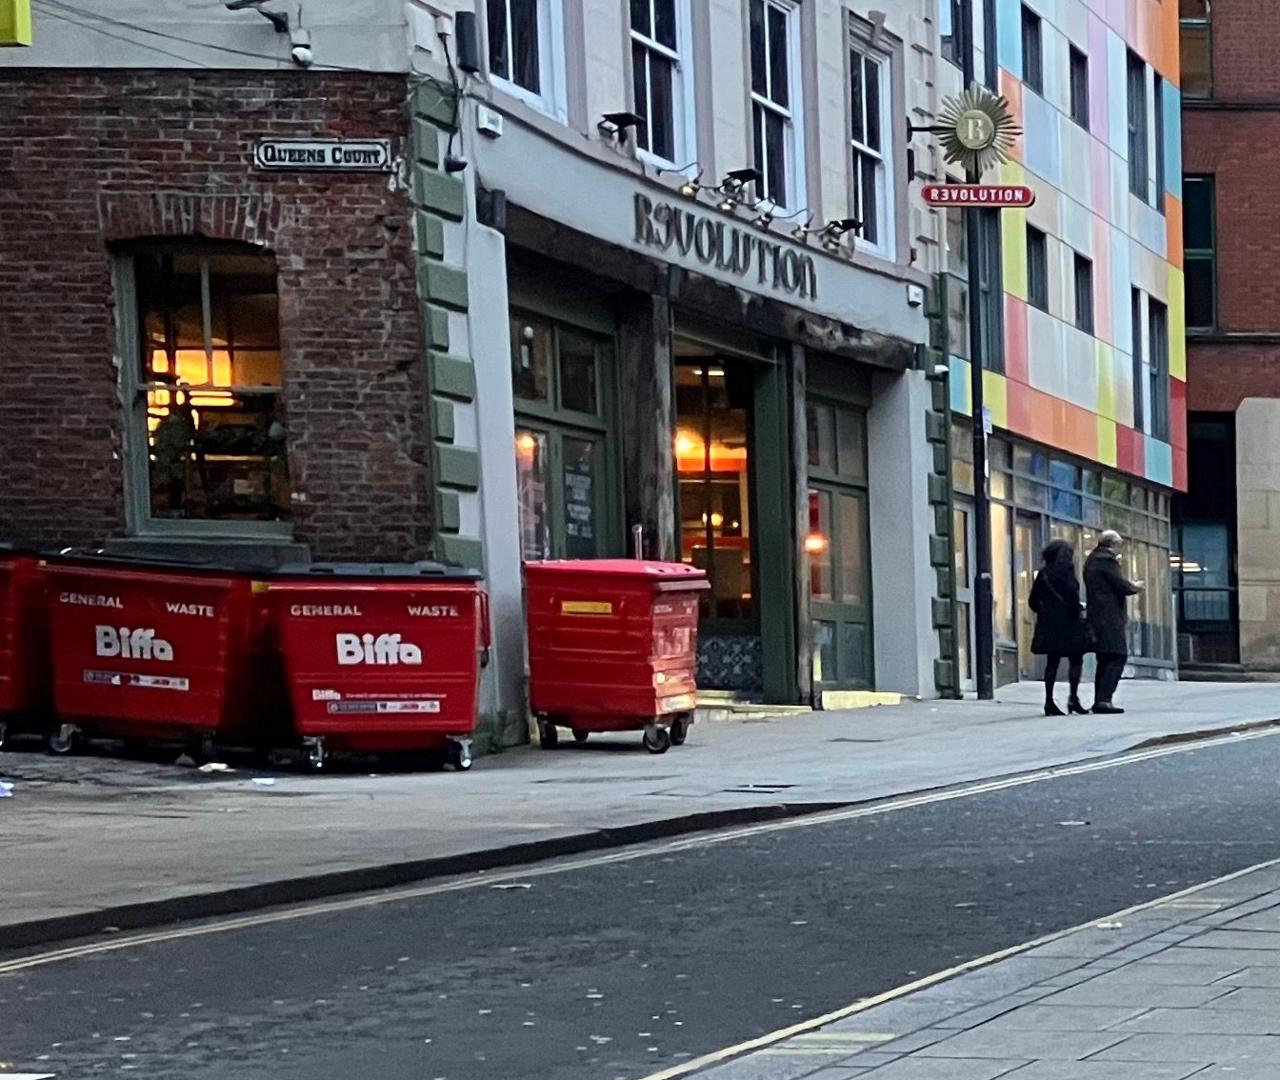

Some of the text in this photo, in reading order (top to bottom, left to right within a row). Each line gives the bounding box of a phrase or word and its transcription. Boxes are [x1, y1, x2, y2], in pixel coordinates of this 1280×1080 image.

[263, 145, 381, 164] QUEENS COURT
[59, 592, 216, 618] GENERAL WASTE
[290, 604, 460, 617] GENERAL WASTE
[95, 624, 175, 662] Biffa
[335, 632, 423, 666] Biffa
